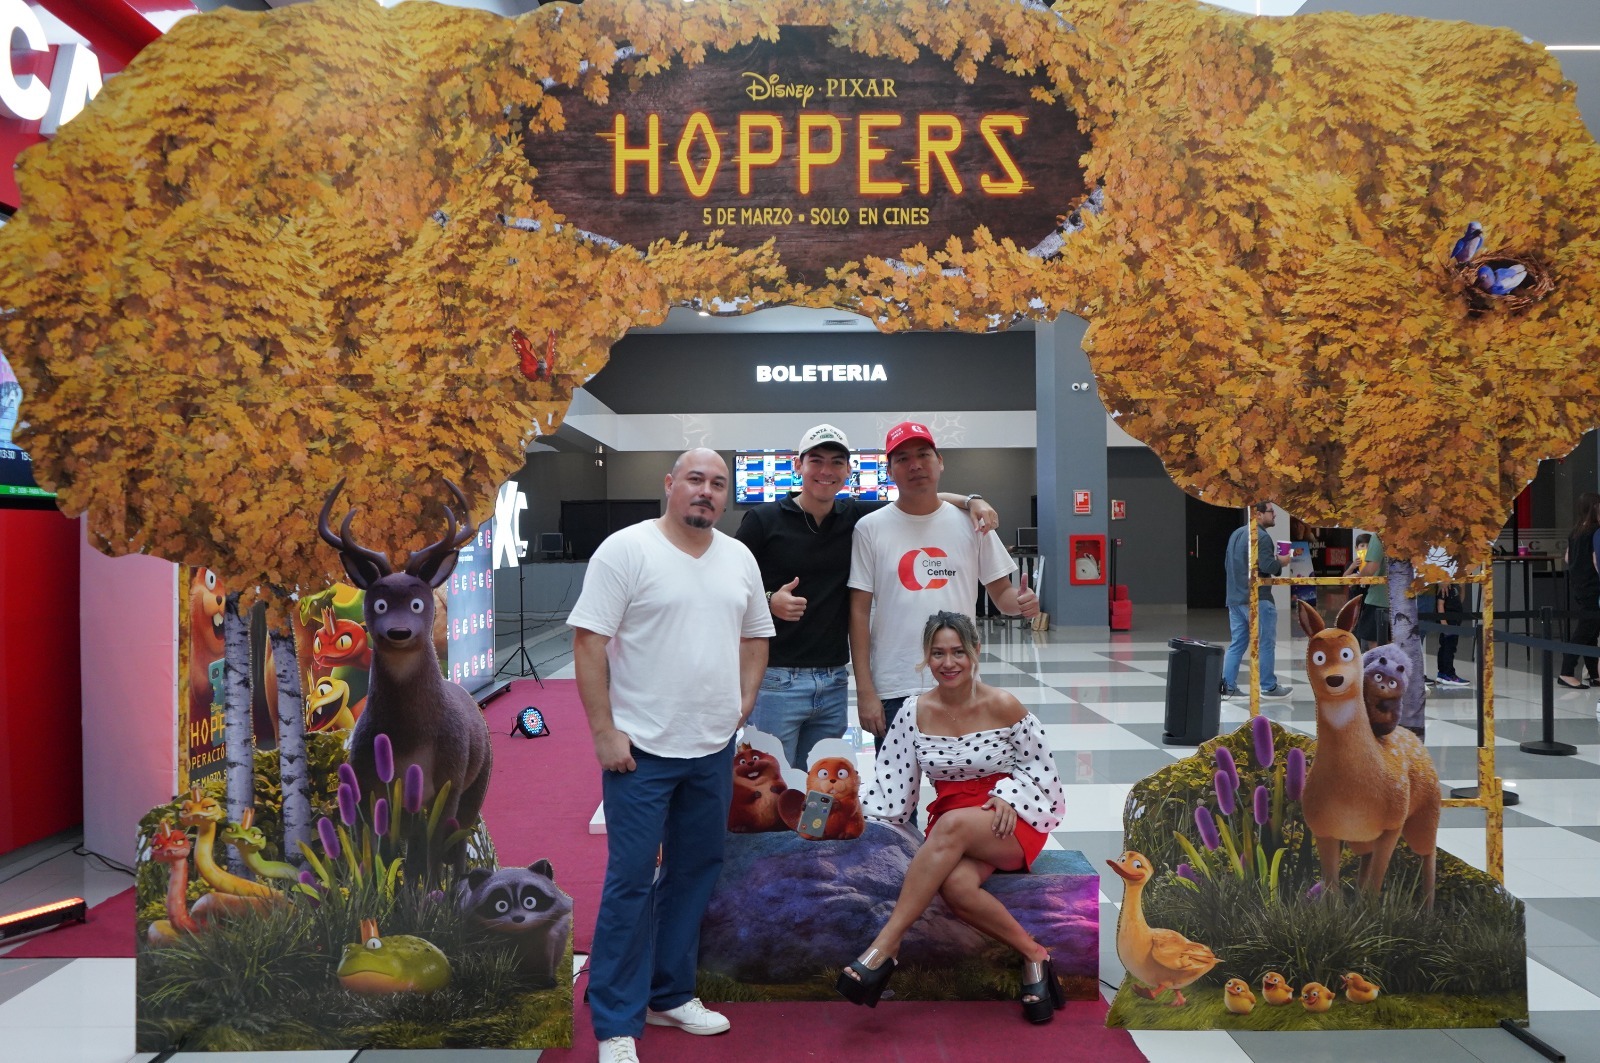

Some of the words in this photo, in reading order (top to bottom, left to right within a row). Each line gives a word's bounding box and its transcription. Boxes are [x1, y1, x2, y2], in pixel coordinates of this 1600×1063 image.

[742, 72, 814, 107] Disney
[826, 78, 897, 98] PIXAR
[608, 111, 1028, 198] HOPPERS
[703, 208, 712, 225] 5
[716, 208, 737, 225] DE
[741, 208, 793, 225] MARZO
[810, 208, 850, 225] SOLO
[859, 208, 878, 225] EN
[883, 208, 930, 225] CINES
[756, 364, 888, 382] BOLETERIA
[922, 559, 942, 568] Cine
[927, 568, 957, 577] Center
[187, 743, 227, 772] PERACIÓ
